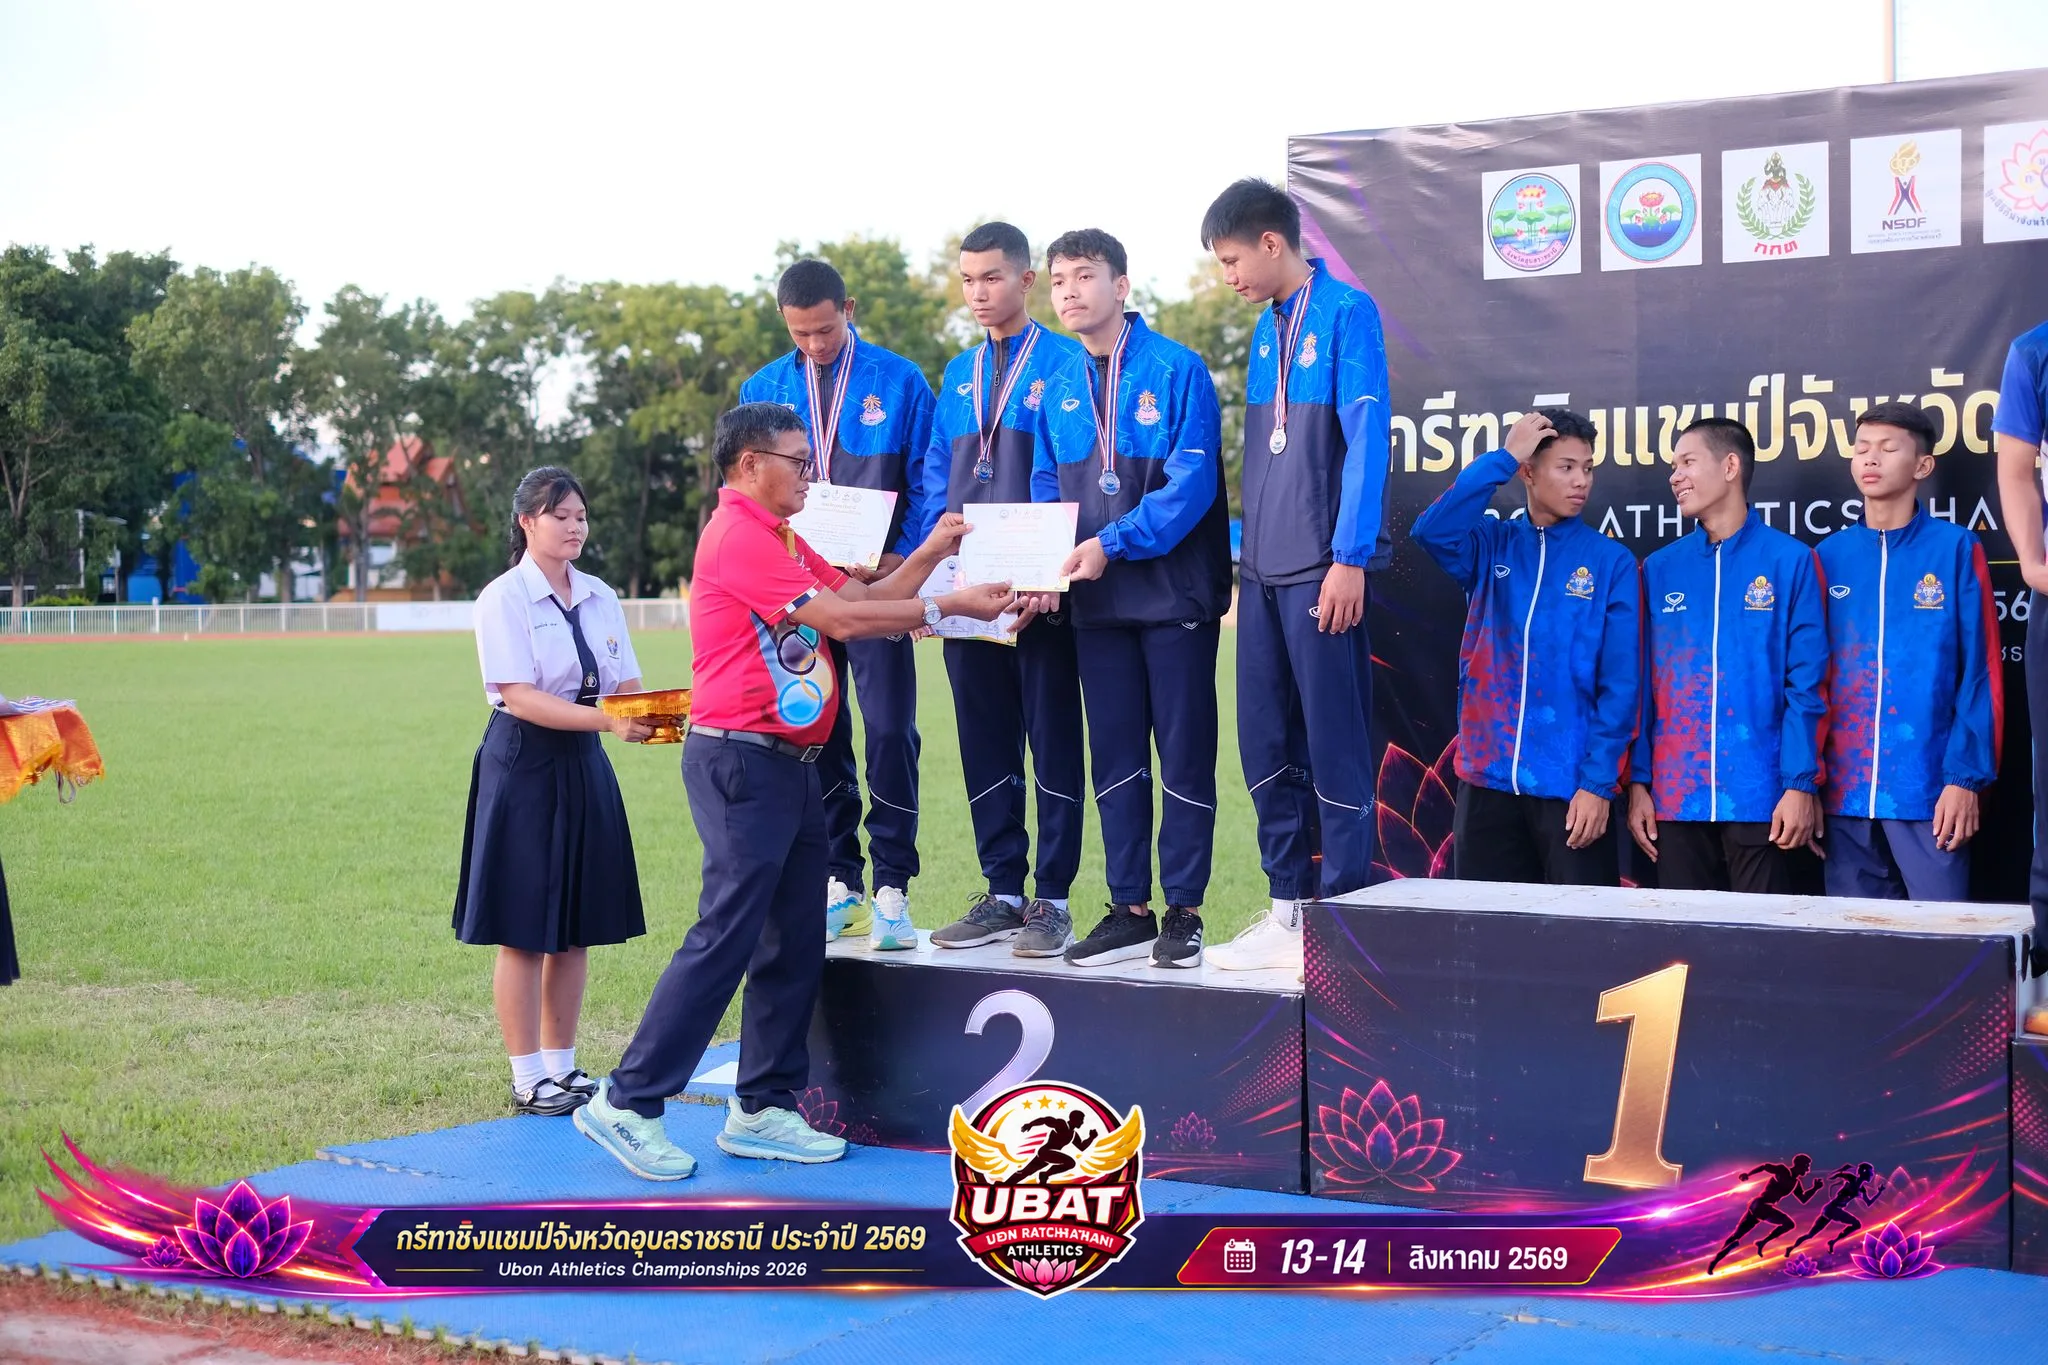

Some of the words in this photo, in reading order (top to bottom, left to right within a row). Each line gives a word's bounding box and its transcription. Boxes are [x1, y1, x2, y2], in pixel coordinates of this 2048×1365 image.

[1881, 217, 1927, 231] NSDF
[1583, 964, 1689, 1189] 1
[612, 1122, 641, 1152] HOKA
